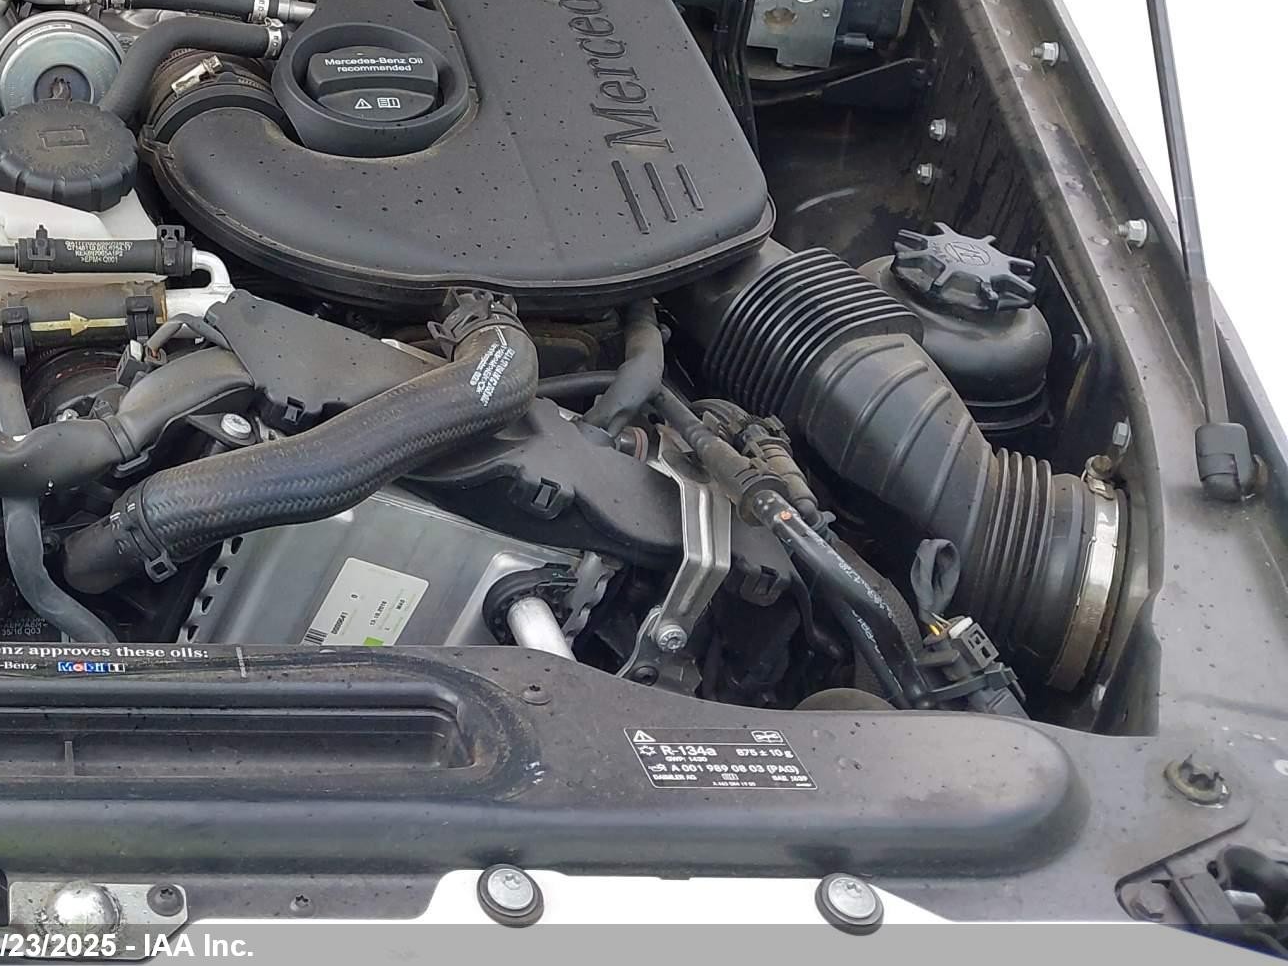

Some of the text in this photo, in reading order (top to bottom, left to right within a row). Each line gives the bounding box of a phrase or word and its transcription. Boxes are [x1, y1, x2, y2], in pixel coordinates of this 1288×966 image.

[324, 56, 424, 66] Mercedes-Benz Oil
[337, 64, 412, 73] recommended
[28, 646, 111, 658] approves
[116, 646, 165, 658] these
[170, 647, 209, 658] oils:
[57, 660, 108, 673] Mobil
[659, 745, 718, 756] R-134a
[681, 764, 704, 772] 001
